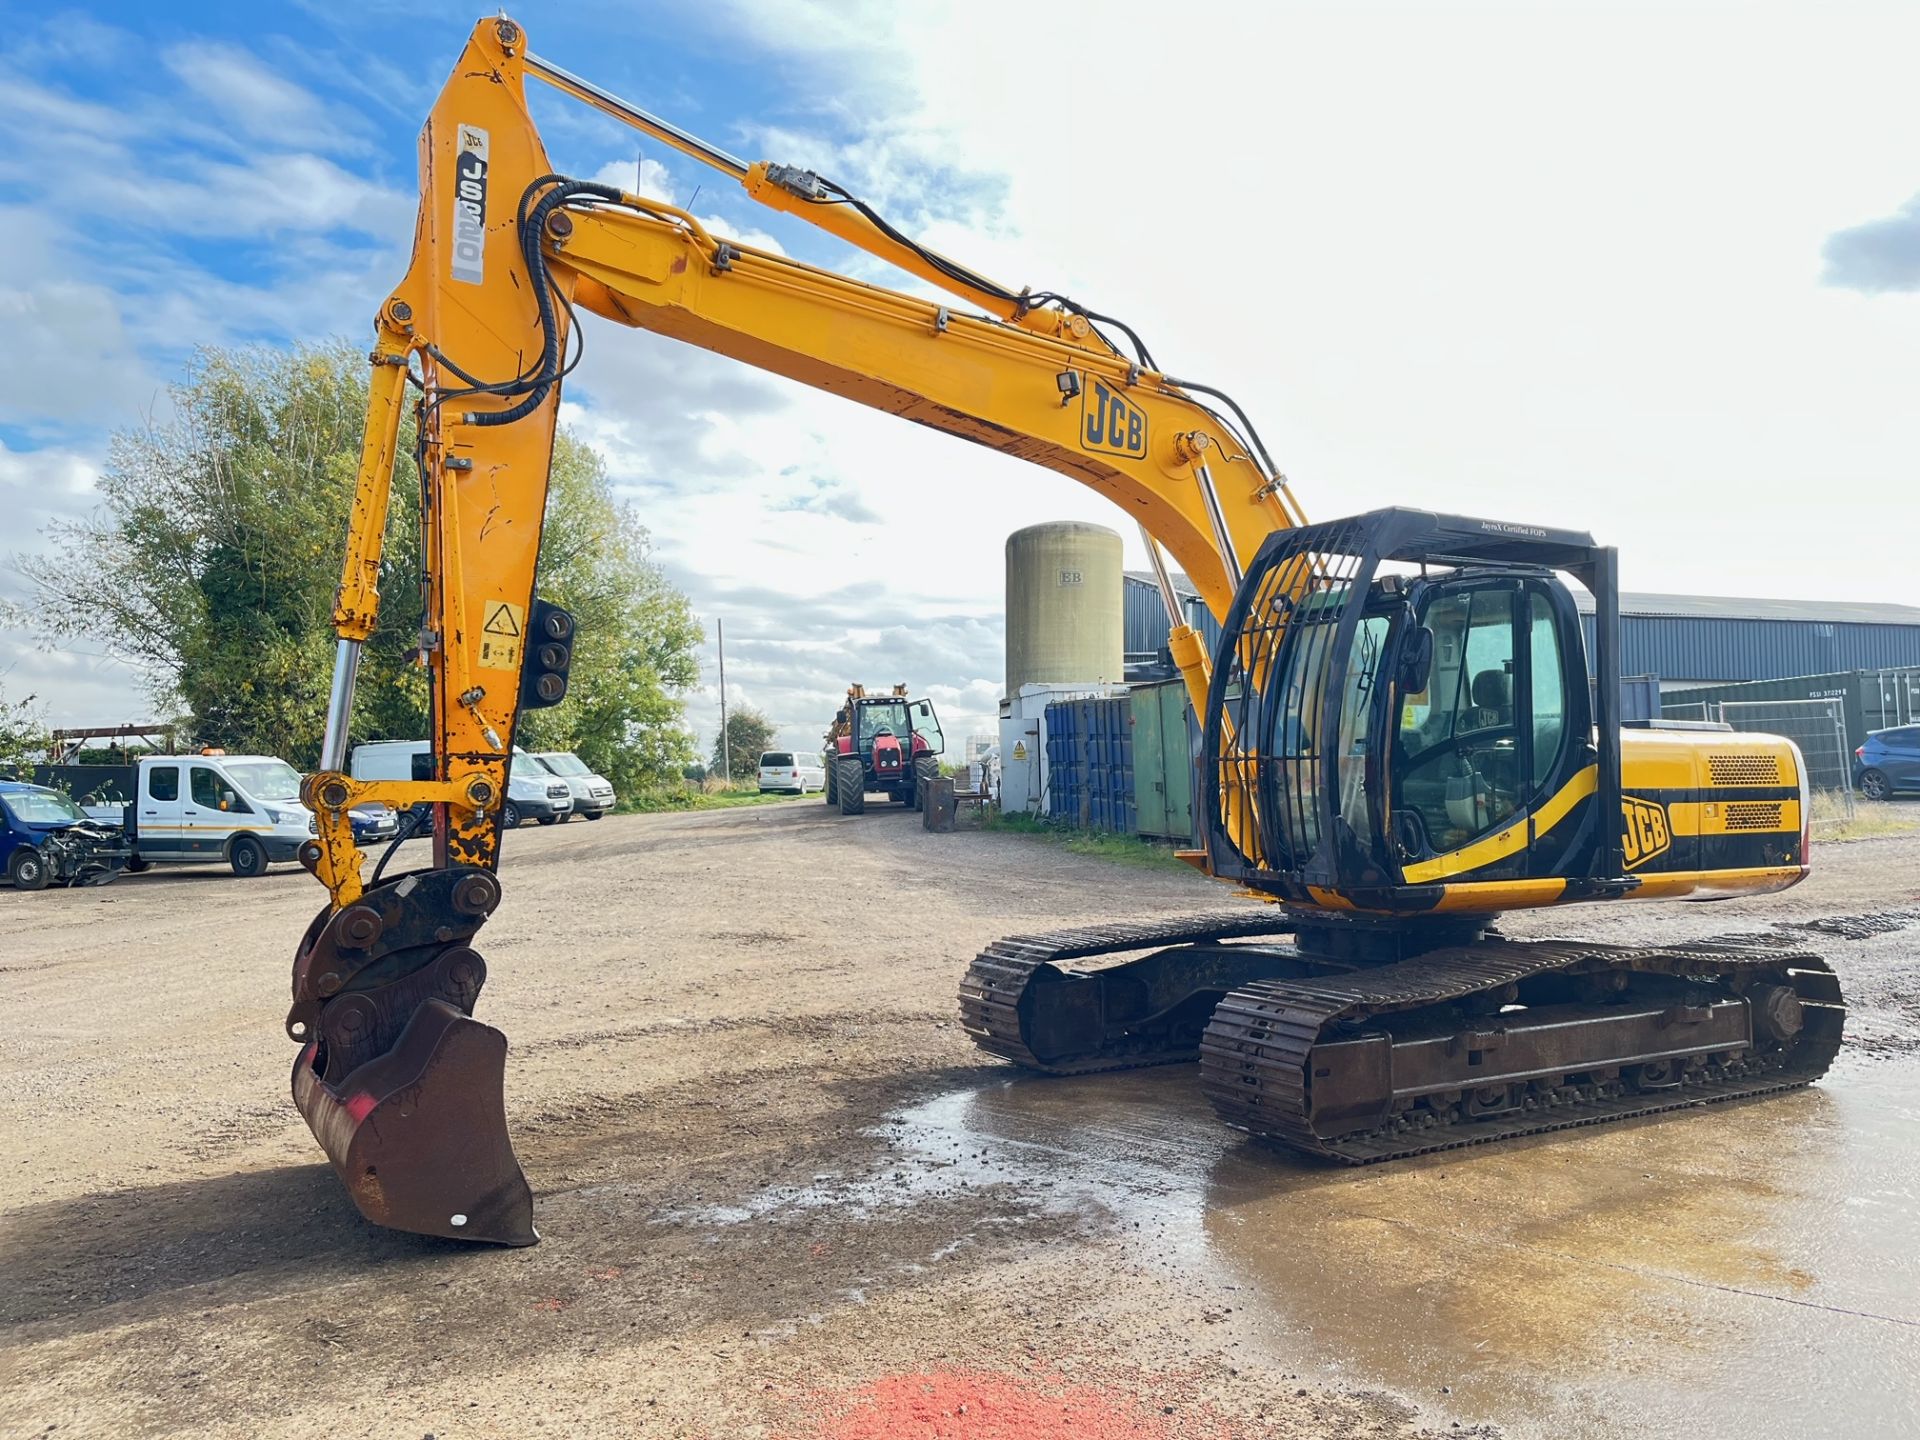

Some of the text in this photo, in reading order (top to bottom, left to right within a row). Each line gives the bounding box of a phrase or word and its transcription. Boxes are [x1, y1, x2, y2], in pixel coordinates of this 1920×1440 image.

[1086, 381, 1142, 451] JCB
[1503, 524, 1528, 535] Certified
[1529, 527, 1546, 537] FOPS
[1621, 801, 1667, 862] JCB
